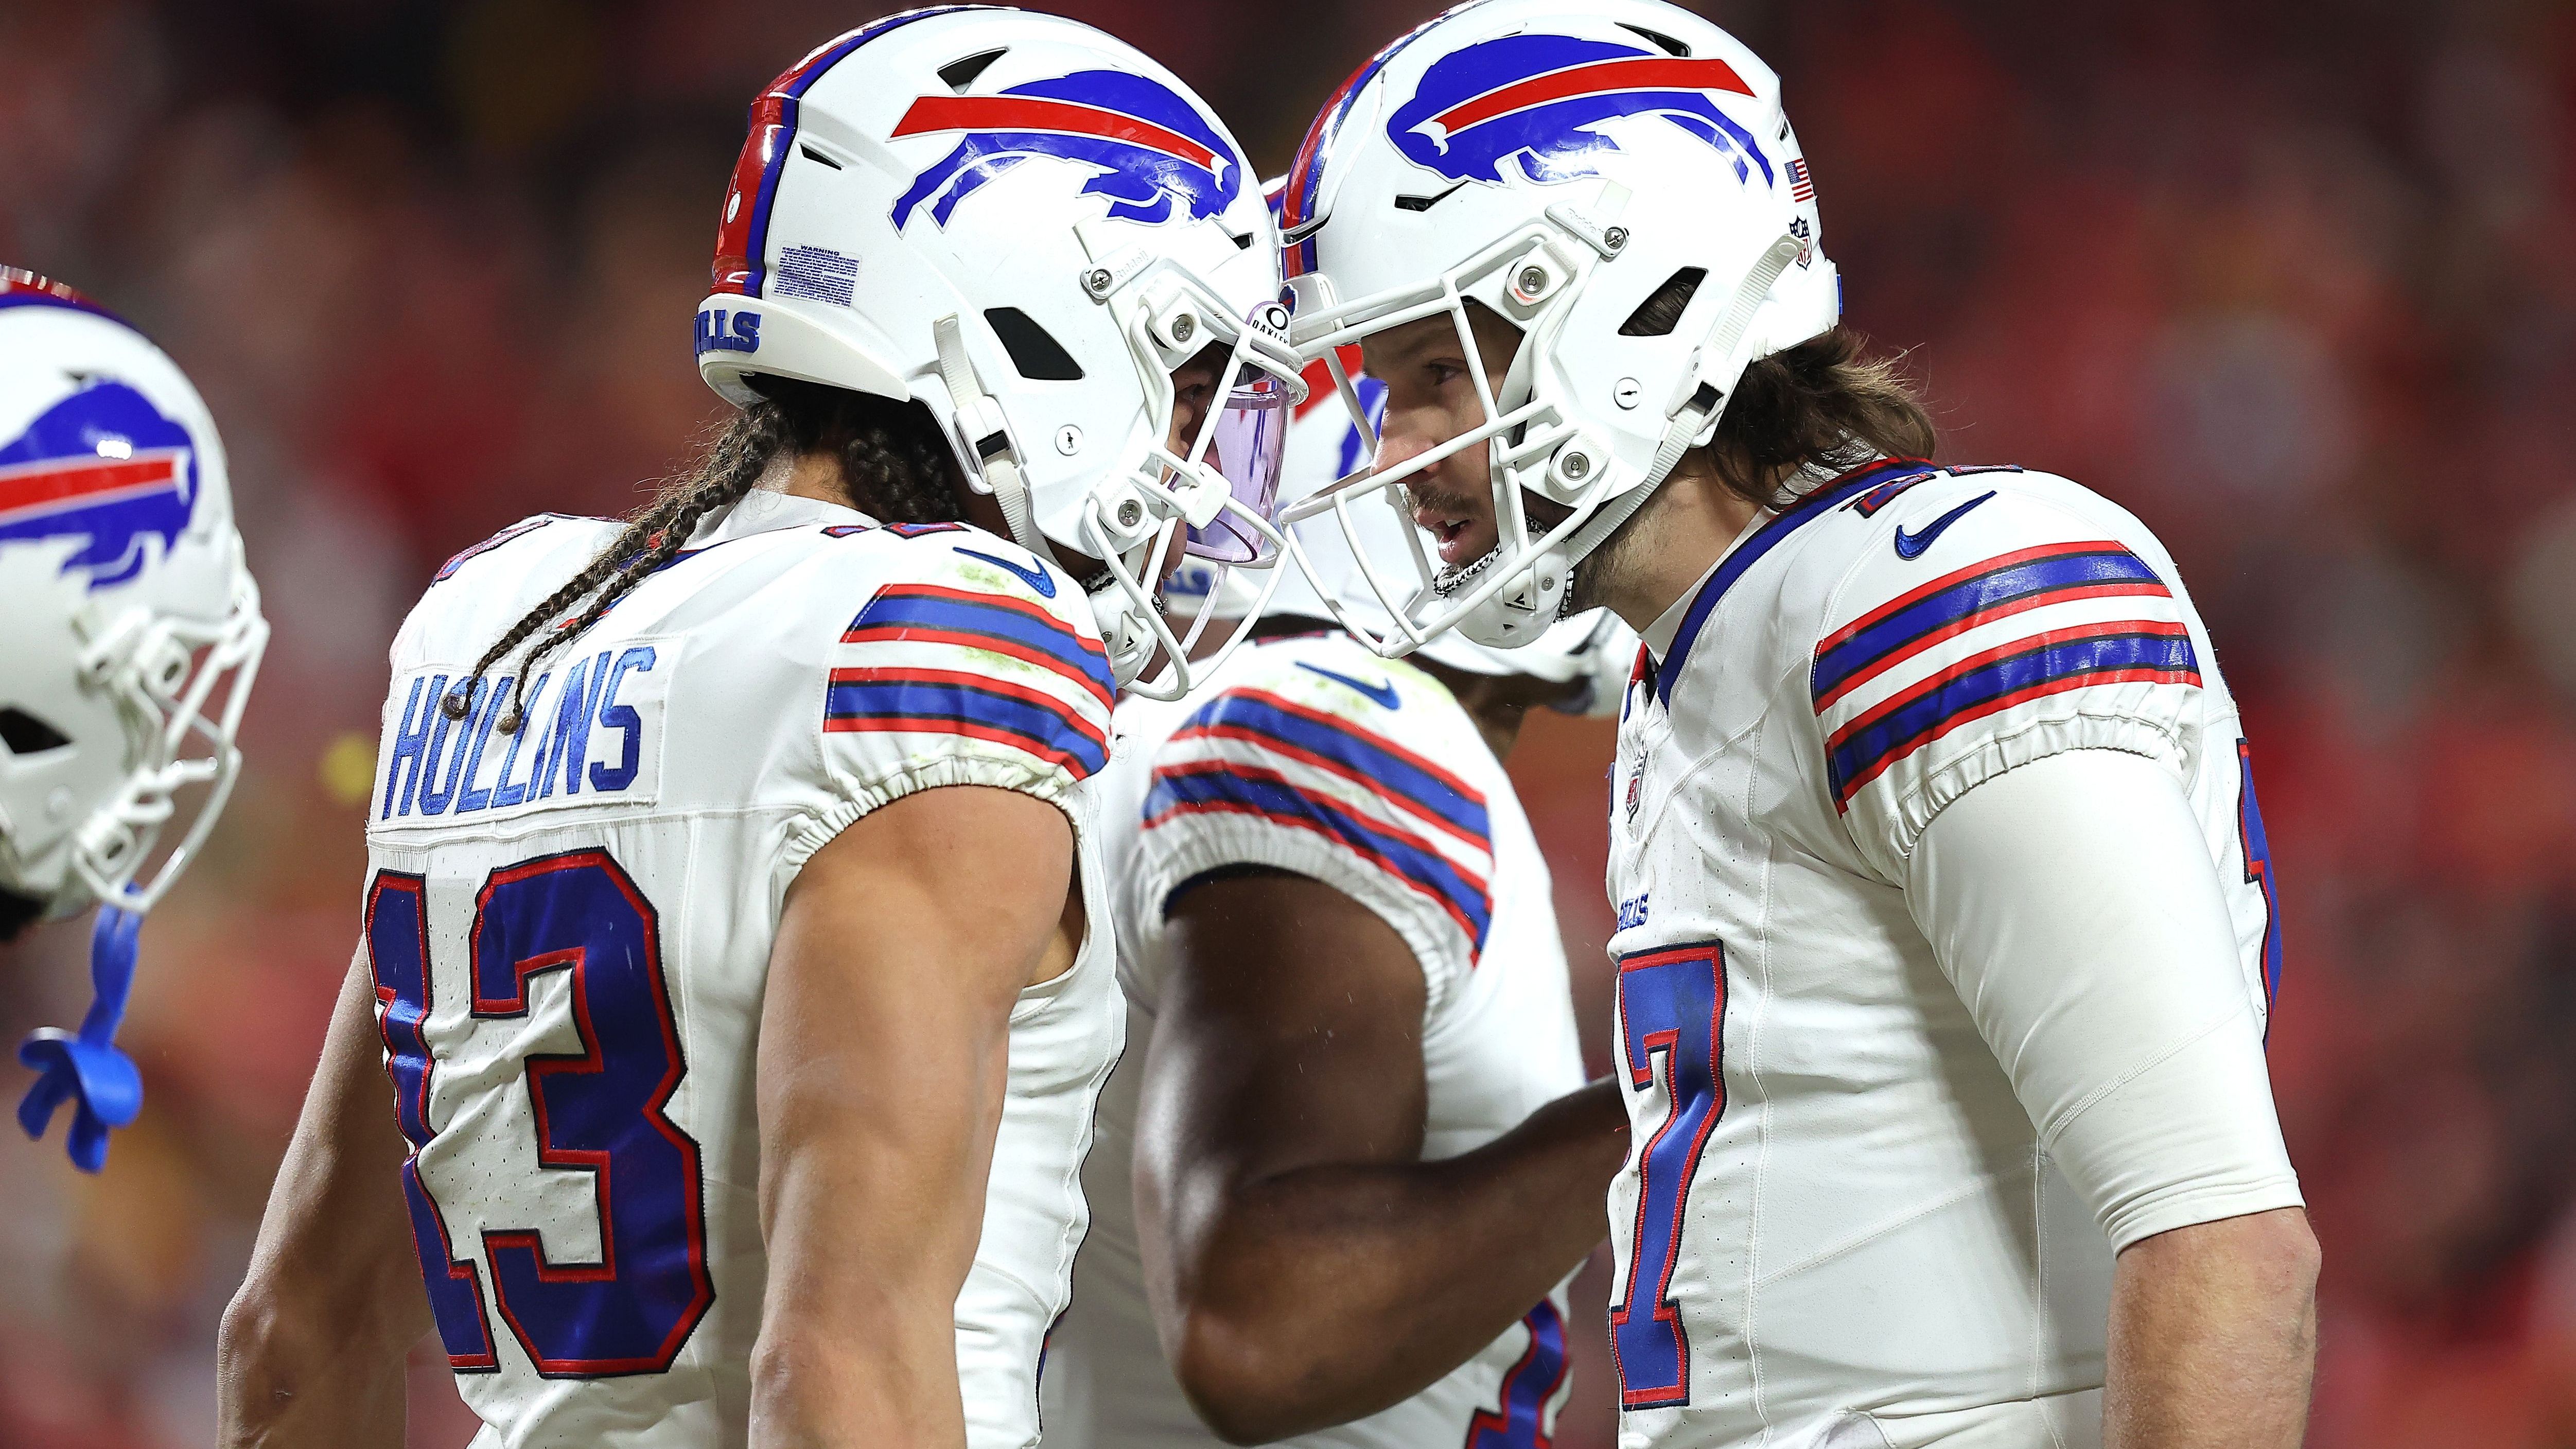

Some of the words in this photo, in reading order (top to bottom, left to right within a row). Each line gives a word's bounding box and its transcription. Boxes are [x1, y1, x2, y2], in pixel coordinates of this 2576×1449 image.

[800, 245, 840, 256] WARNING
[382, 646, 656, 820] HOLLINS
[364, 846, 716, 1378] 13
